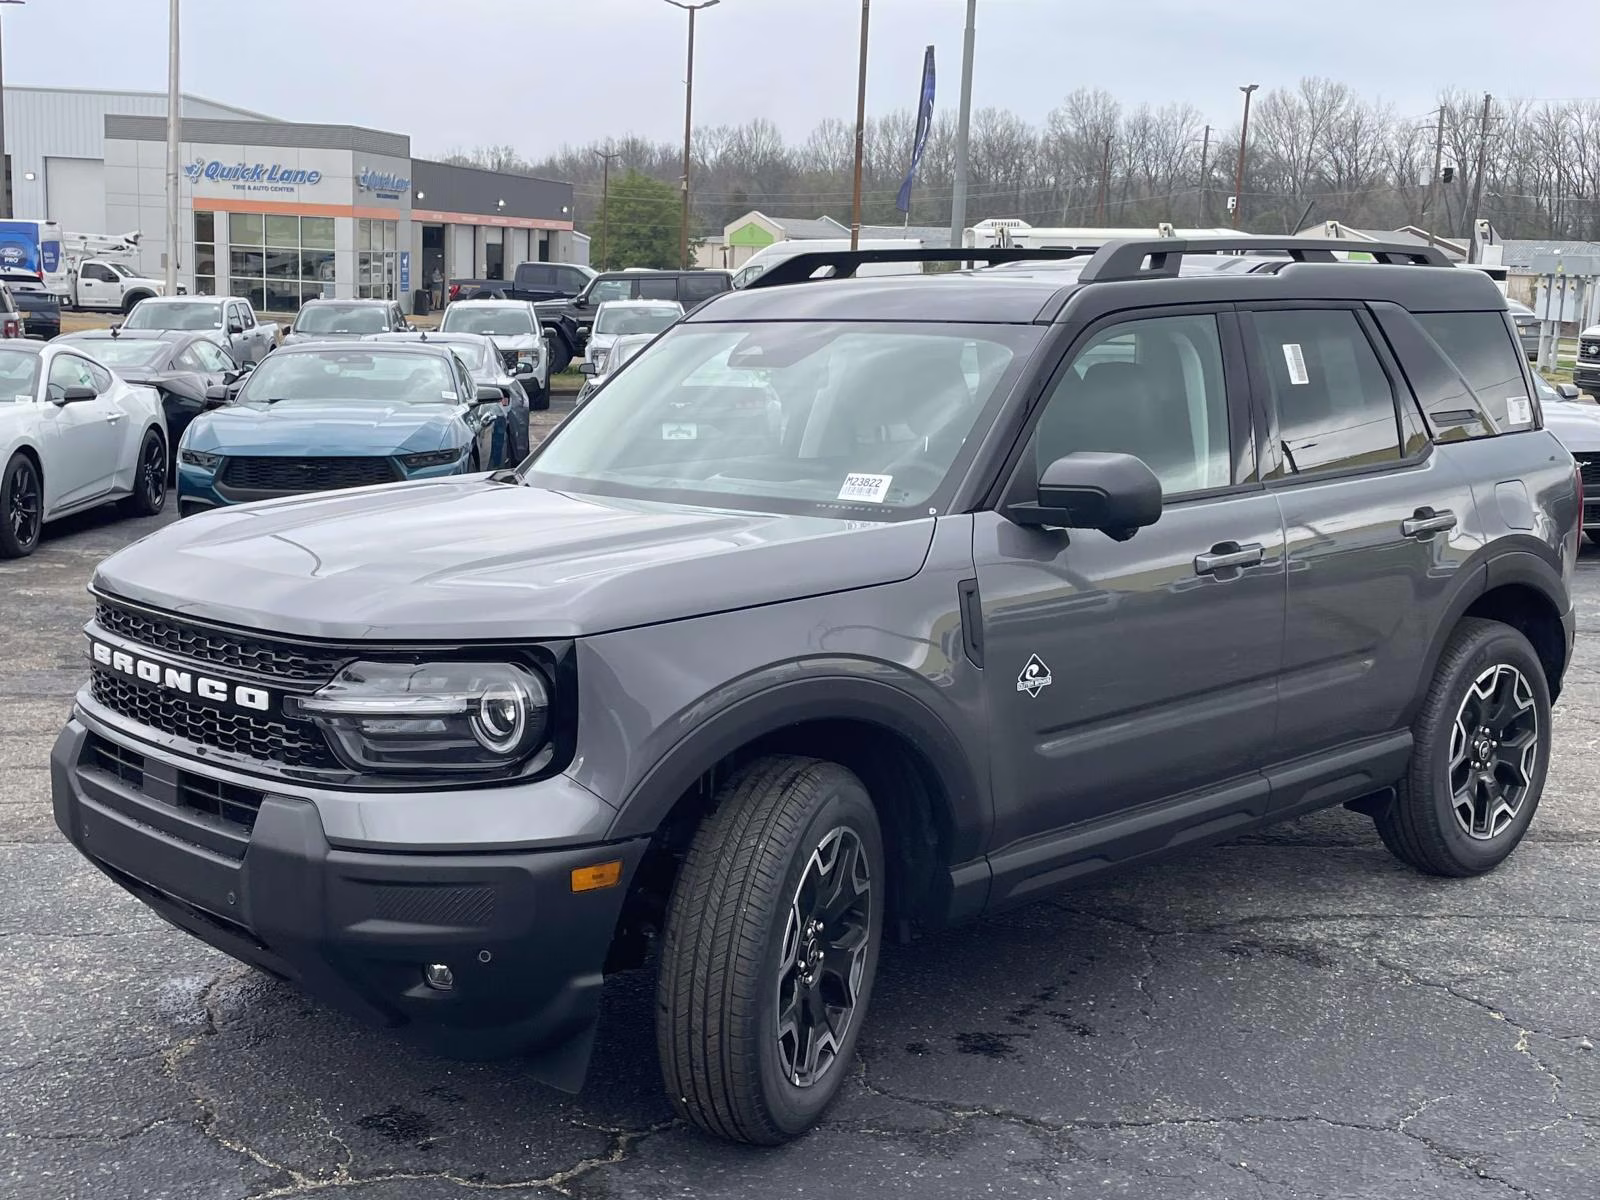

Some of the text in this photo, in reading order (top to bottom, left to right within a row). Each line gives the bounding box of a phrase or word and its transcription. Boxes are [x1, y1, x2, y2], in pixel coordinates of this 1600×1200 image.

[204, 160, 321, 185] Quick Lane
[93, 642, 269, 711] BRONCO
